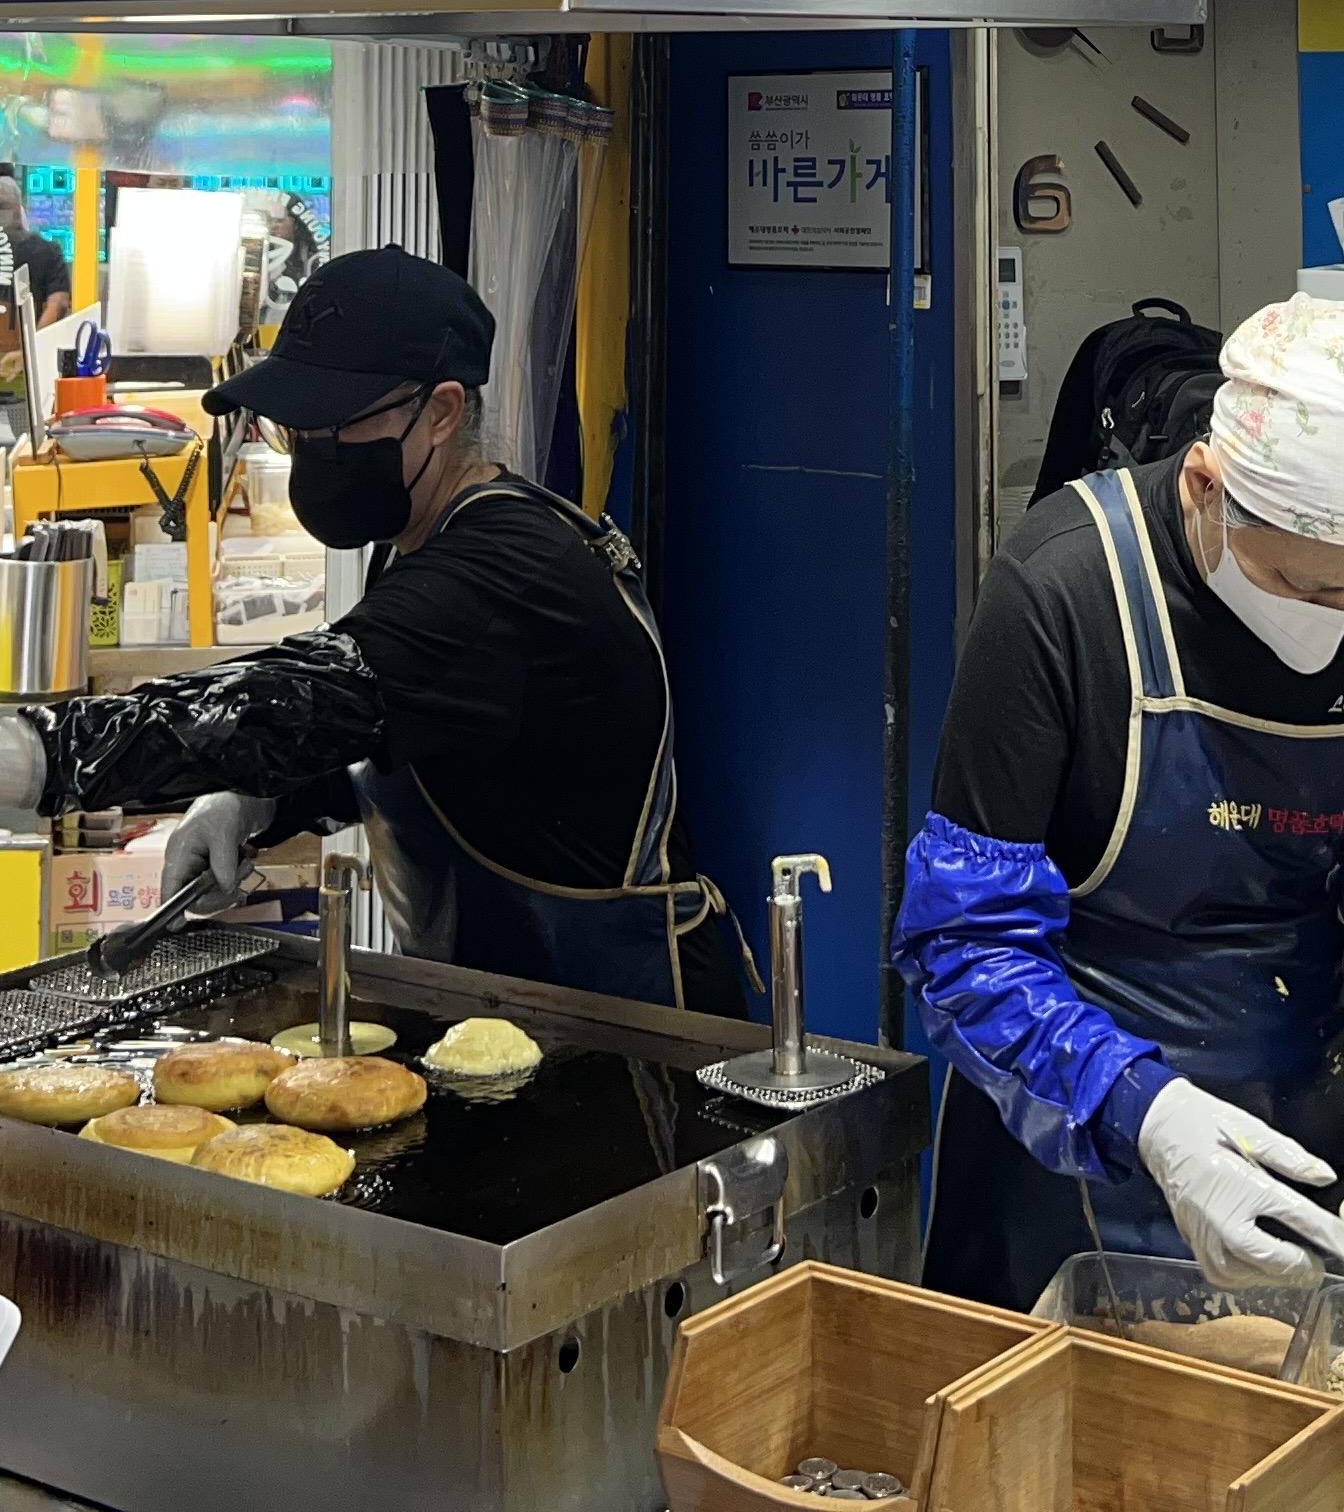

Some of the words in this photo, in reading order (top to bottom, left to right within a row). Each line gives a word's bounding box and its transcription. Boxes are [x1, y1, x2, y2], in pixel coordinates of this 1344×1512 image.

[748, 129, 810, 151] 씀씀이가
[1013, 154, 1072, 234] 6
[1207, 799, 1262, 831] 해운대
[63, 869, 103, 914] 회
